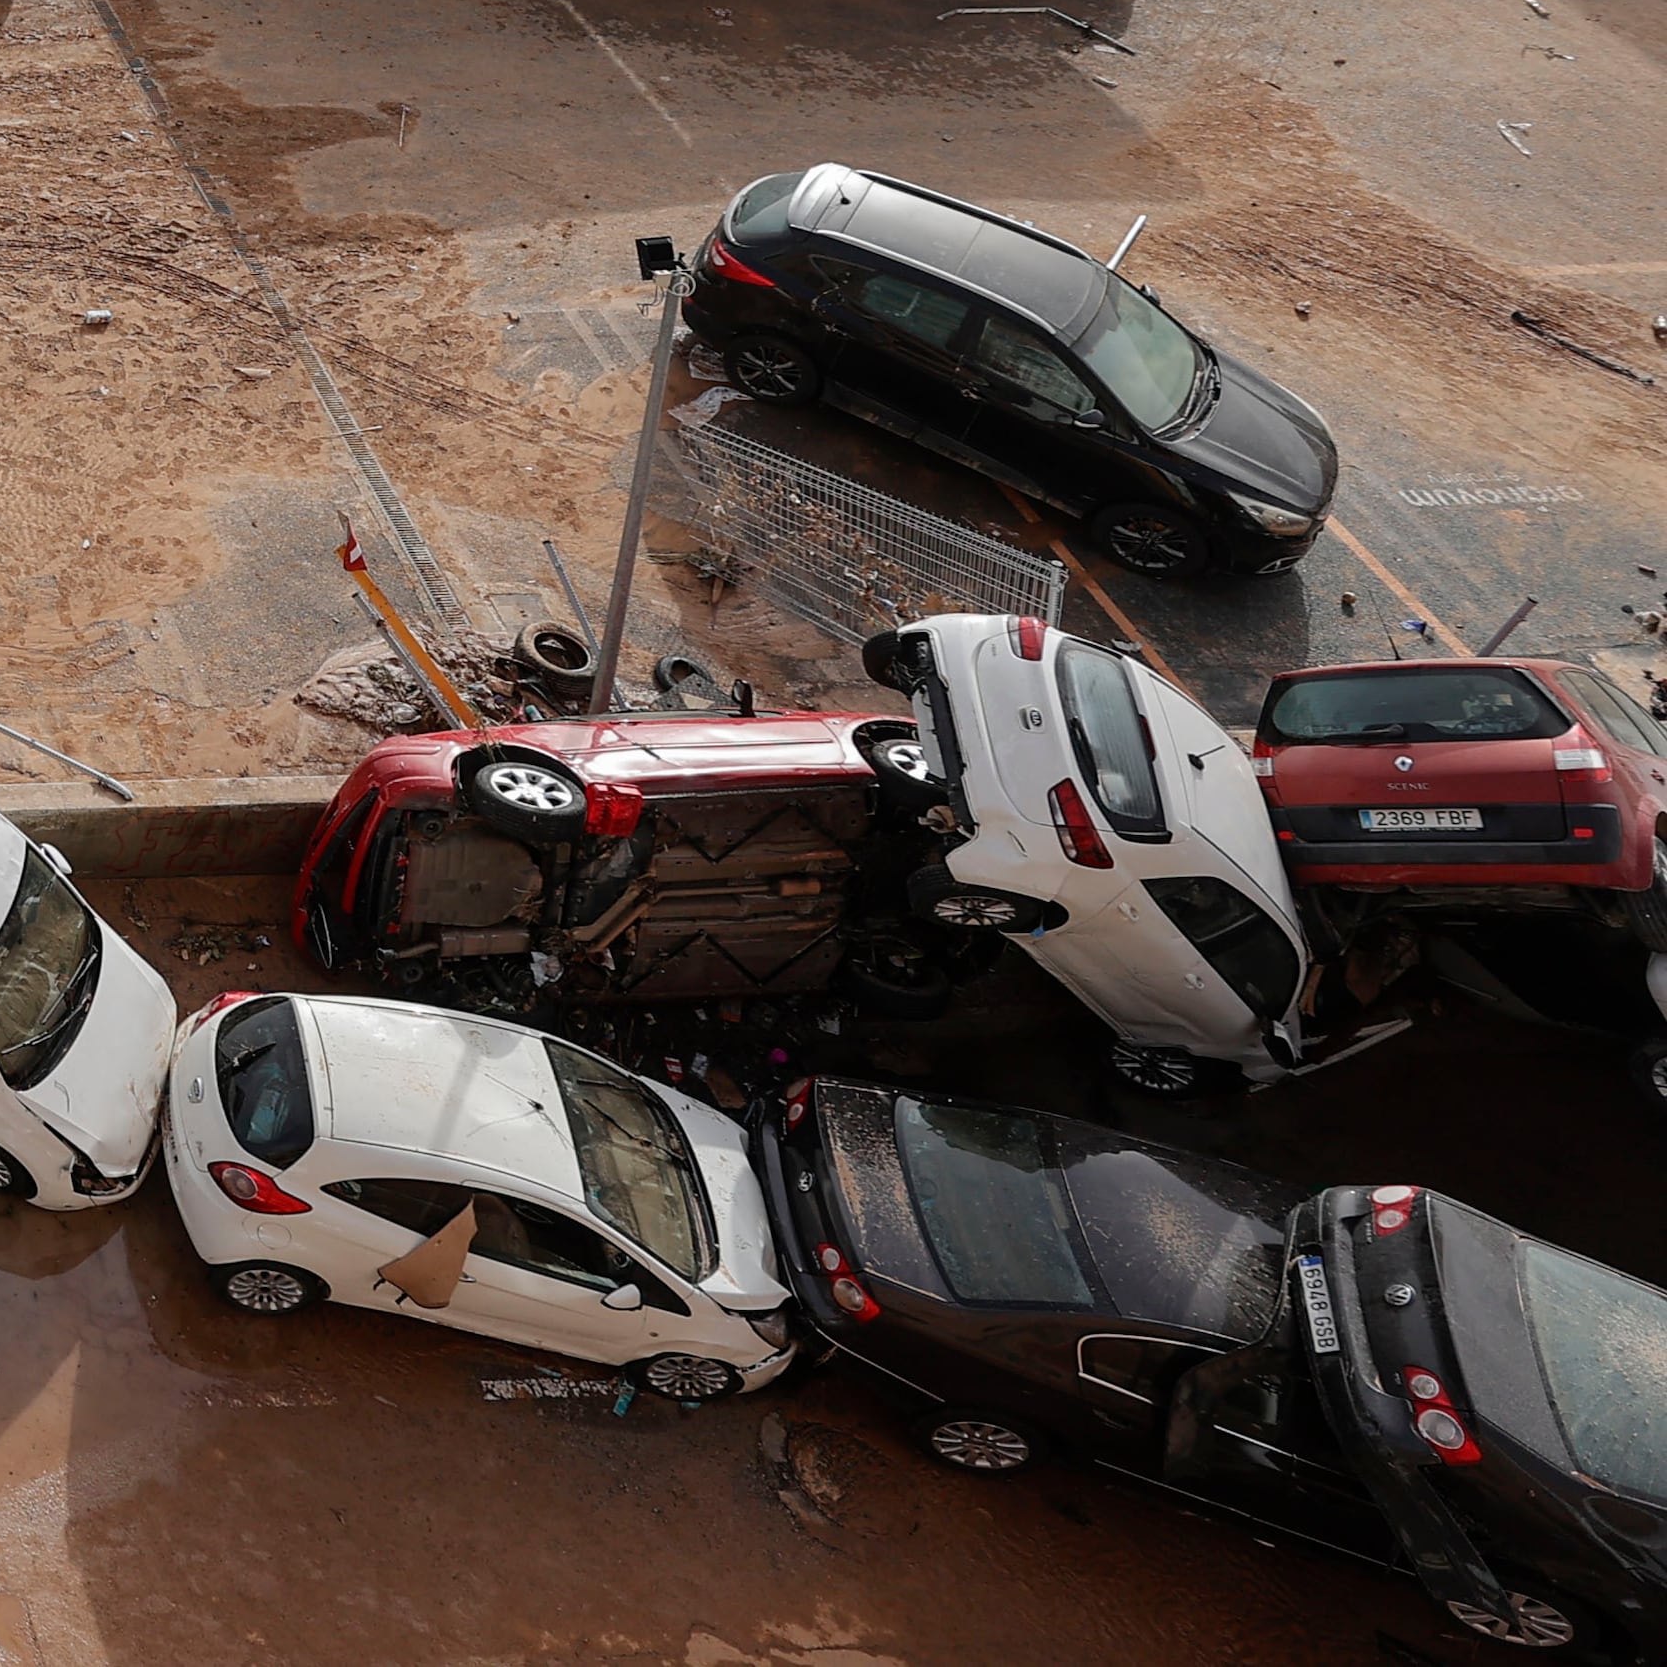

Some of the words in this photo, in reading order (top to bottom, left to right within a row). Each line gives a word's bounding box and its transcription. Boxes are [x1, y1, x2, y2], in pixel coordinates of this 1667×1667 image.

[1387, 782, 1429, 791] SCENIC
[1375, 811, 1426, 826] 2369
[1436, 810, 1473, 825] FBF
[1305, 1266, 1329, 1312] 6948
[1313, 1315, 1337, 1350] GSB
